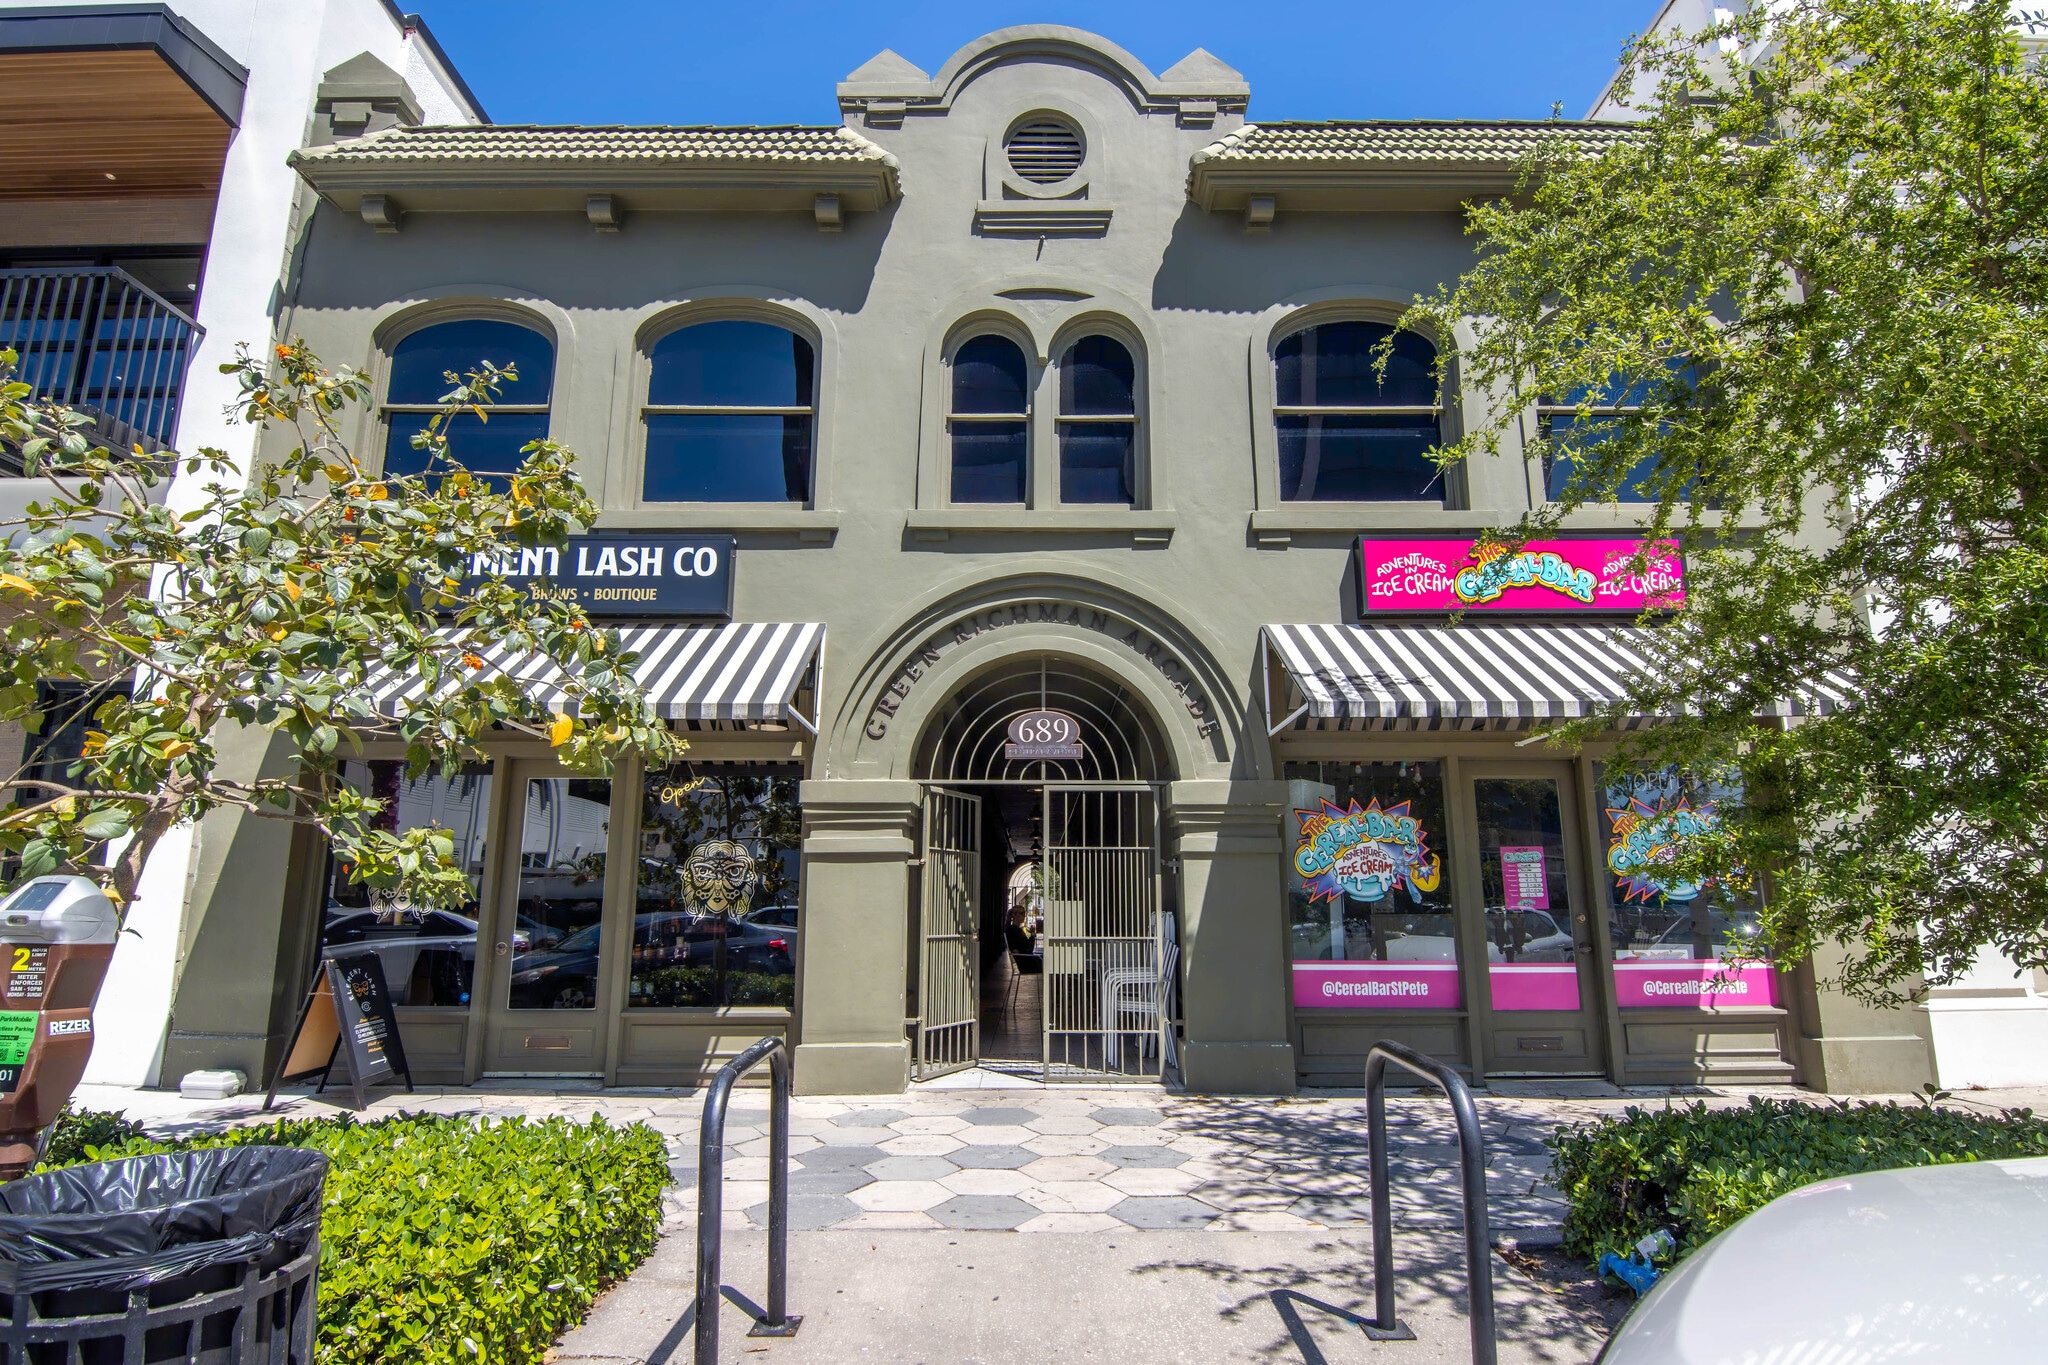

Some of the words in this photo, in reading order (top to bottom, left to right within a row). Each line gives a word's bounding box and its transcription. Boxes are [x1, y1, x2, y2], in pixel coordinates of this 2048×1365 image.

[576, 546, 666, 577] LASH
[672, 546, 718, 578] CO
[1376, 553, 1447, 577] ADVENTURES
[1404, 566, 1418, 574] IN
[1371, 575, 1404, 597] ICE
[1404, 572, 1455, 596] CREAM
[1540, 554, 1594, 600] BAR
[593, 588, 657, 602] BOUTIQUE
[866, 643, 942, 741] GREEN
[951, 602, 1109, 645] RICHMAN
[1119, 630, 1221, 740] ARCADE
[1018, 718, 1069, 743] 689
[661, 776, 707, 809] Open
[1303, 813, 1330, 836] THE
[1296, 816, 1367, 873] CEREAL
[1365, 811, 1418, 844] BAR
[1342, 846, 1388, 863] ADVENTURES
[1338, 862, 1359, 876] ICE
[1360, 858, 1393, 875] CREAM
[11, 947, 31, 971] 2
[1322, 980, 1428, 997] @CerealBarStPete
[49, 1019, 91, 1034] REZER
